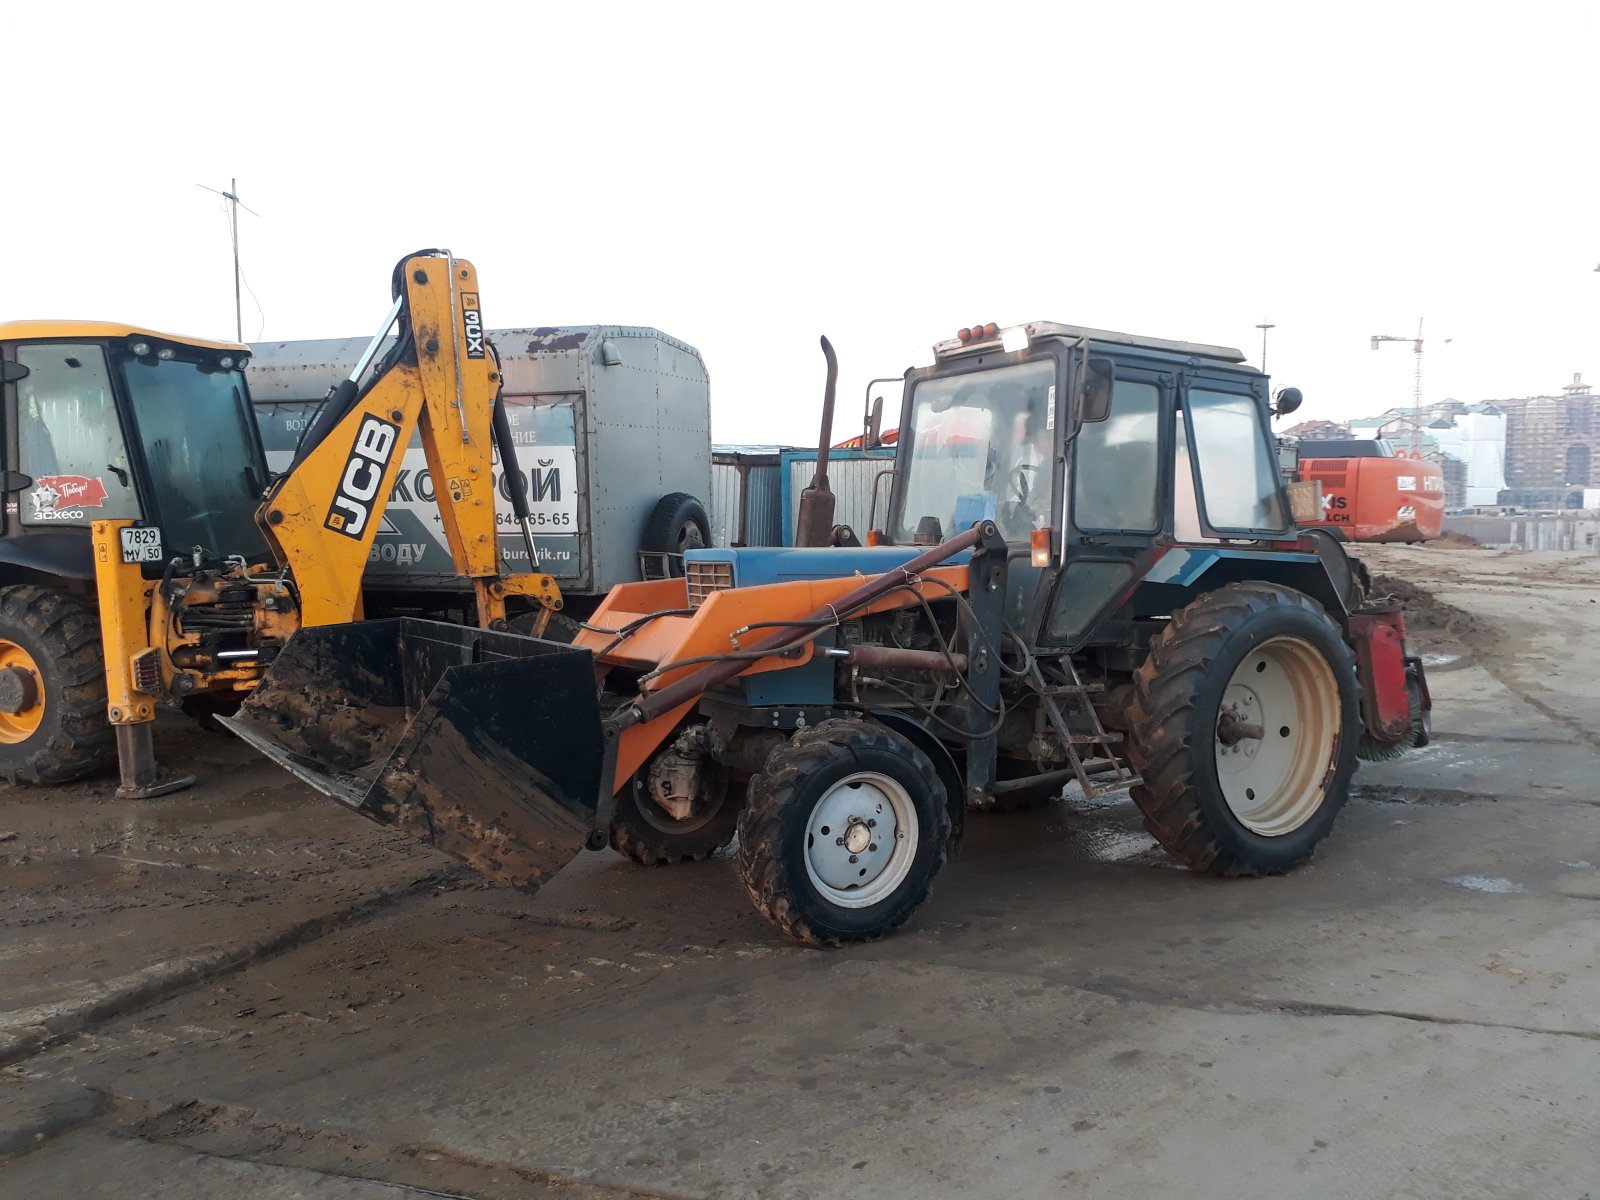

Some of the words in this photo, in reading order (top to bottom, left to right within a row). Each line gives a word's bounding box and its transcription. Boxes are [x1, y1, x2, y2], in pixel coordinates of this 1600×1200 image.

[464, 310, 484, 352] 3CX
[511, 431, 537, 444] НИЕ
[335, 418, 396, 536] JCB
[58, 481, 88, 499] Победа!
[1321, 493, 1348, 510] XIS
[126, 530, 156, 545] 7829
[147, 549, 160, 560] 50
